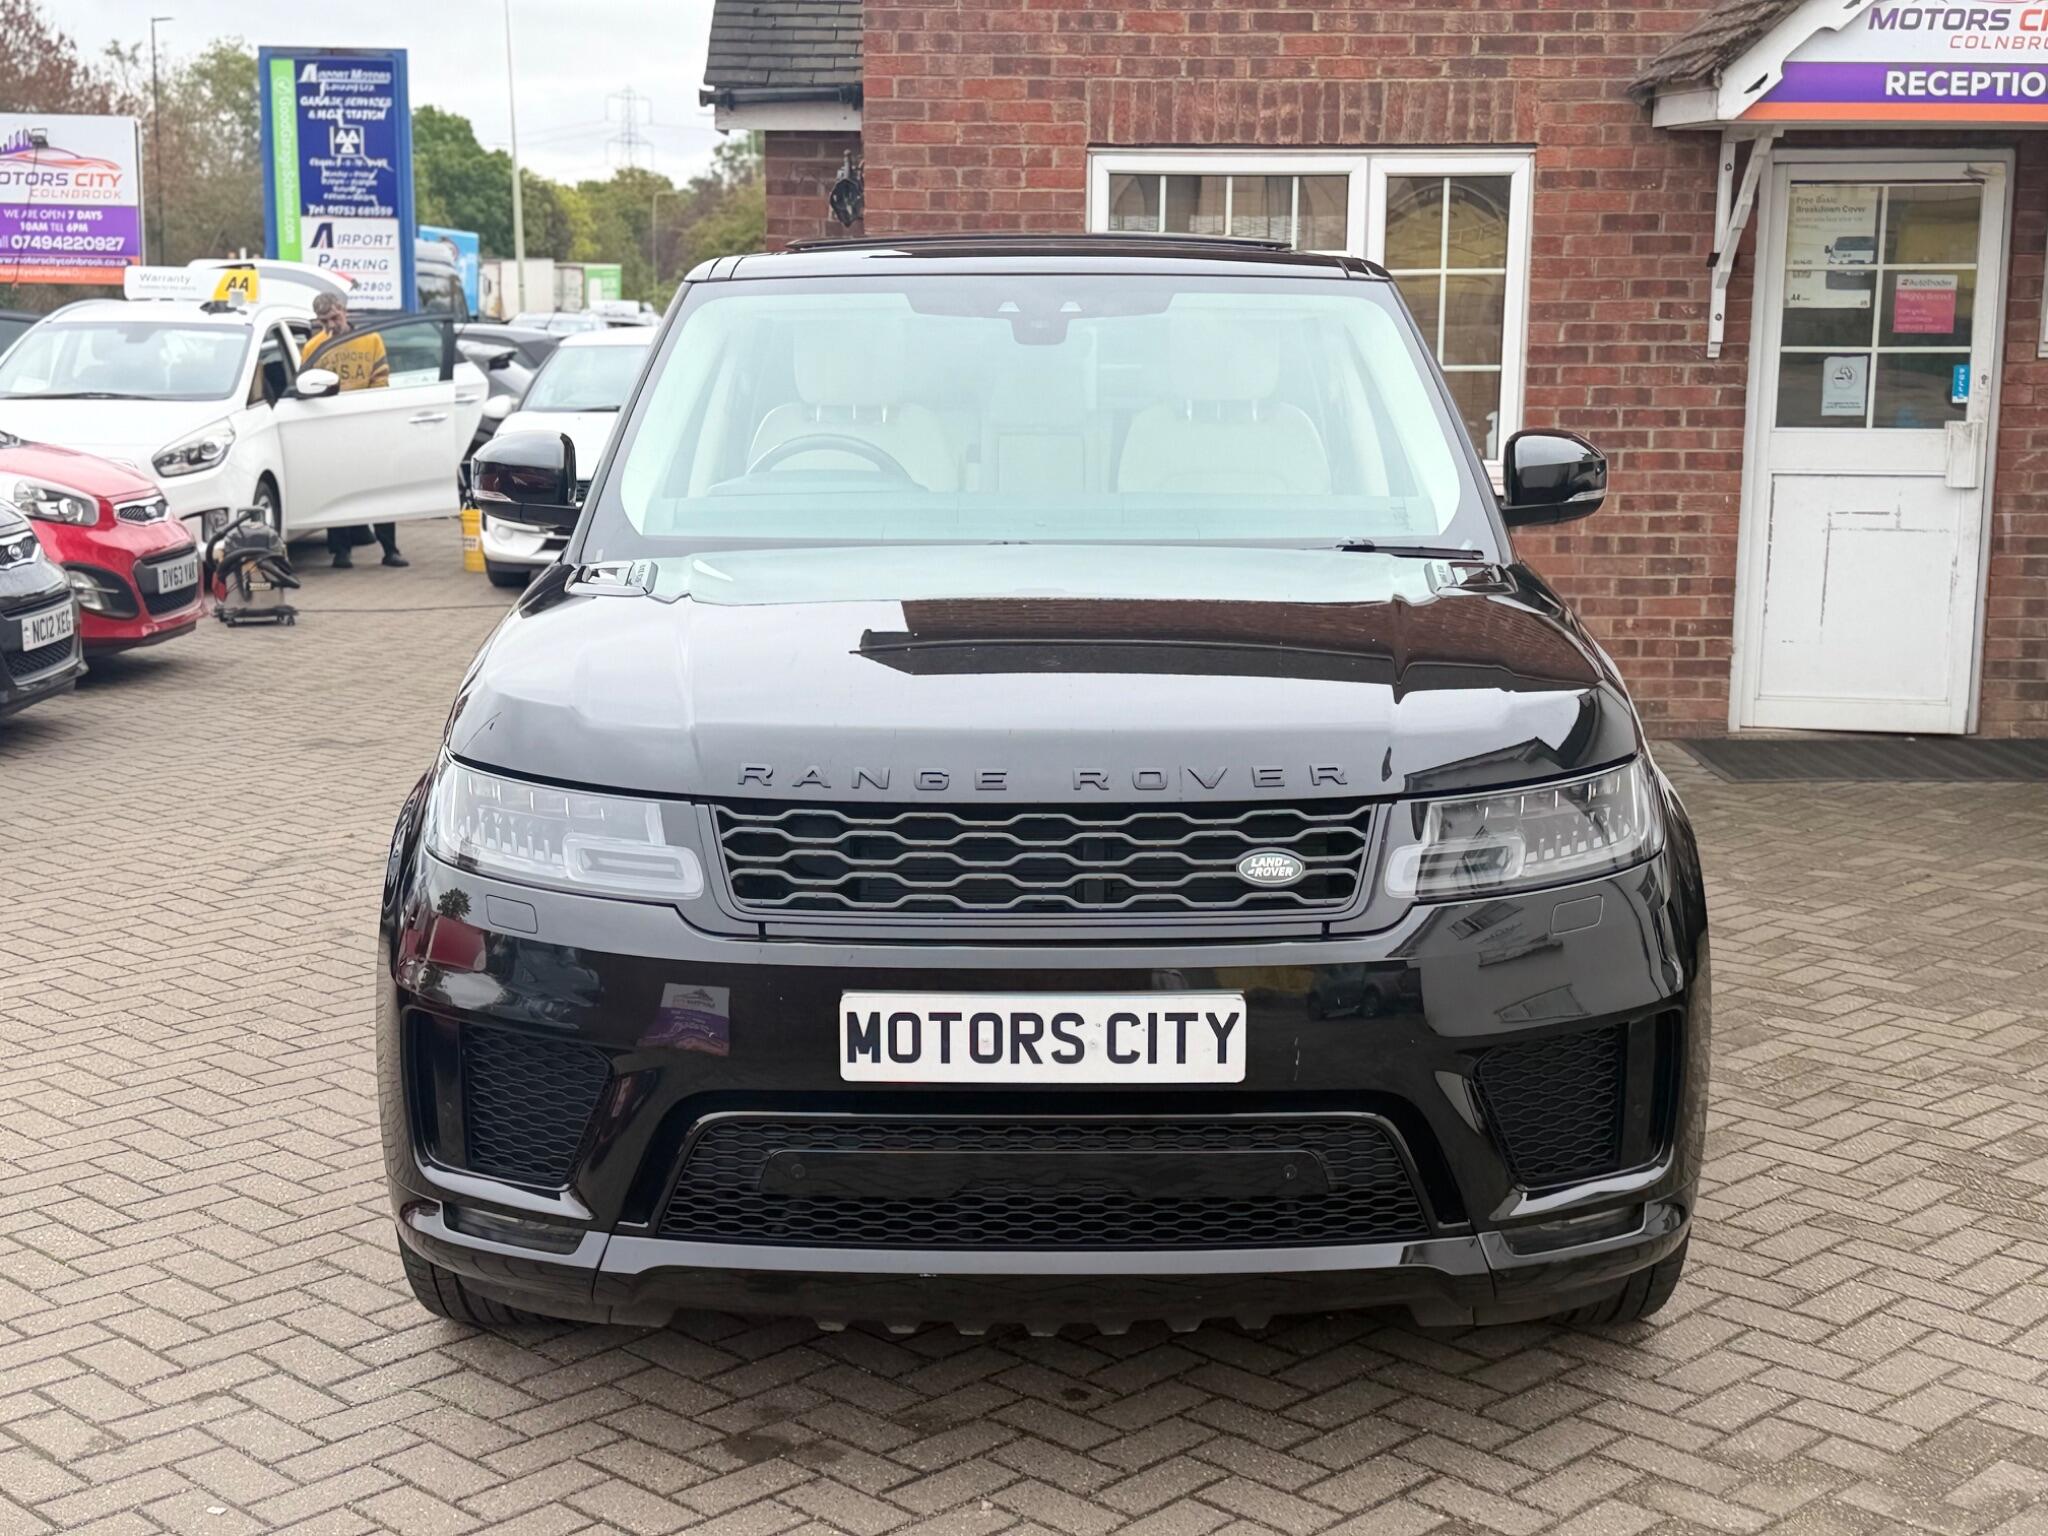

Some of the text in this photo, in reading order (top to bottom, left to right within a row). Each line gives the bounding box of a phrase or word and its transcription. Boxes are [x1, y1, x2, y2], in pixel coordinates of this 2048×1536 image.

[1867, 7, 2011, 31] MOTORS
[75, 173, 122, 188] CITY
[40, 209, 65, 220] OPEN
[67, 210, 75, 220] 7
[77, 210, 103, 221] DAYS
[20, 221, 48, 232] 10AM
[66, 222, 88, 233] 6PM
[309, 222, 393, 248] AIRPORT
[10, 234, 125, 251] 07494220927
[318, 253, 389, 270] PARKING
[139, 273, 192, 285] Warranty
[225, 276, 249, 292] AA
[32, 616, 55, 644] NC12
[737, 762, 1349, 792] RANGE ROVER
[1250, 857, 1282, 867] LAND
[1254, 867, 1294, 877] ROVER
[846, 1011, 1240, 1065] MOTORS CITY
